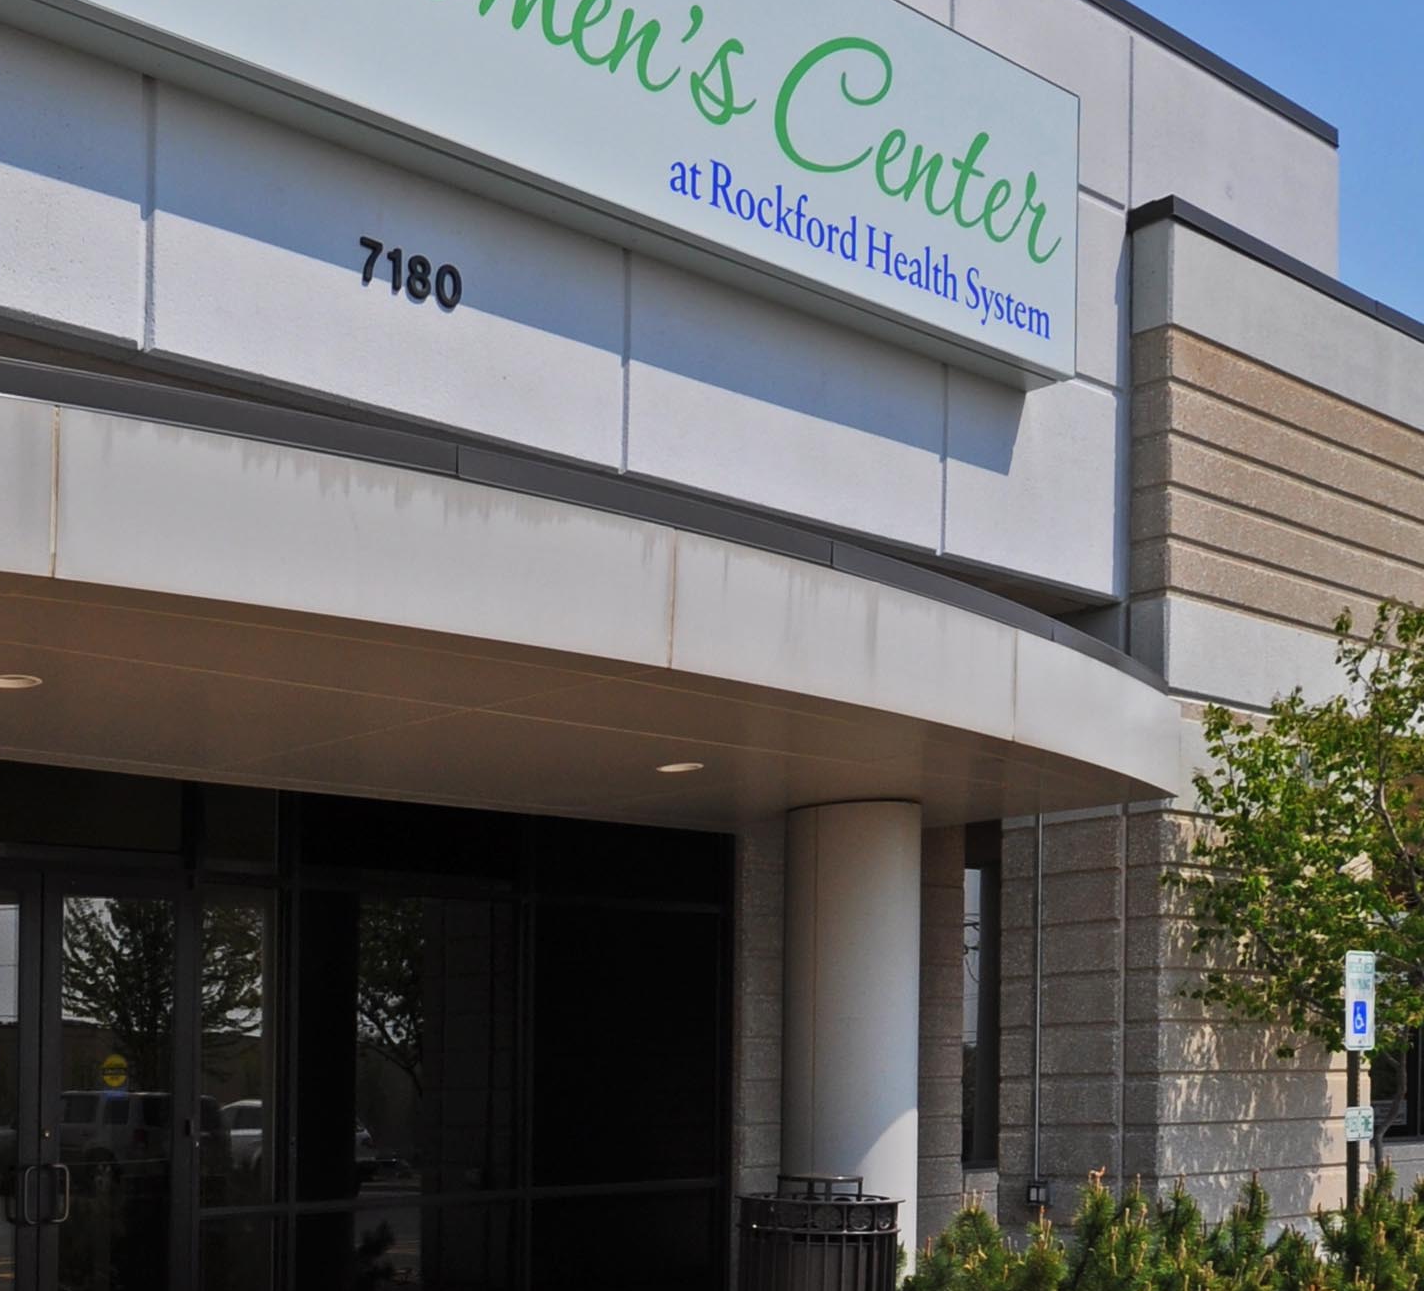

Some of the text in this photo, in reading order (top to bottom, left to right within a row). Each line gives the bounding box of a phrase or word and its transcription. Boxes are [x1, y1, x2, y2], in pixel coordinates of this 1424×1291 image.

[774, 36, 1063, 264] Center
[359, 236, 462, 309] 7180
[669, 159, 1051, 340] at Rockford Health System
